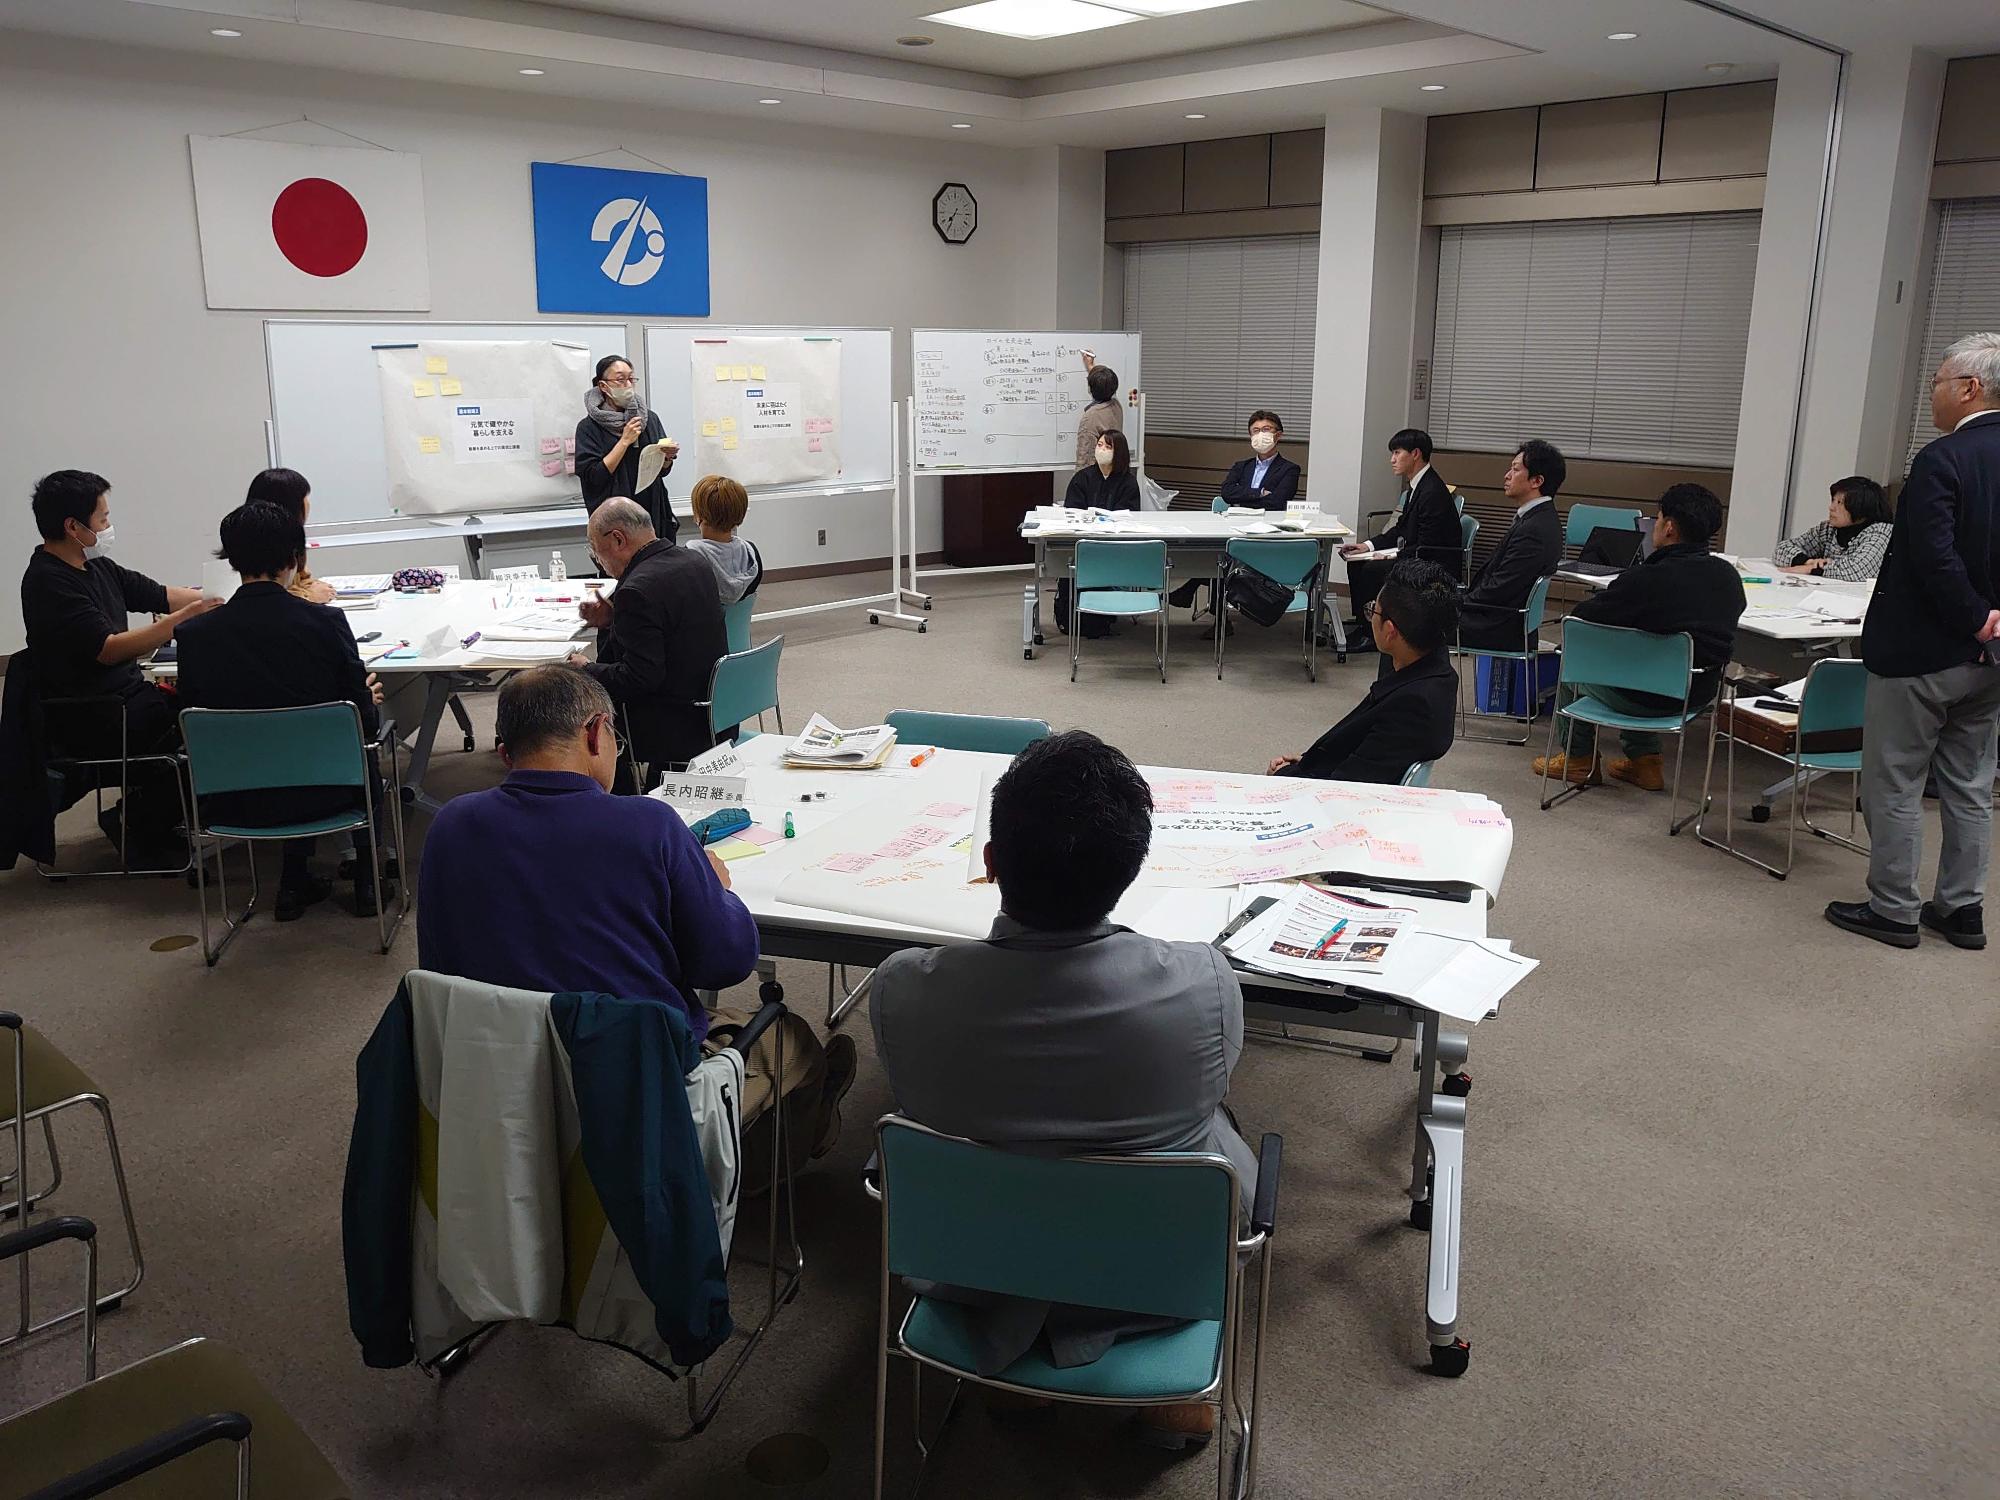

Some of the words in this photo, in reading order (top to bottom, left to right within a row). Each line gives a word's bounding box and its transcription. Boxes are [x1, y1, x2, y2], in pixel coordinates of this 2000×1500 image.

[471, 420, 515, 428] 元気で健やかな
[473, 429, 514, 437] 暮らしを支える
